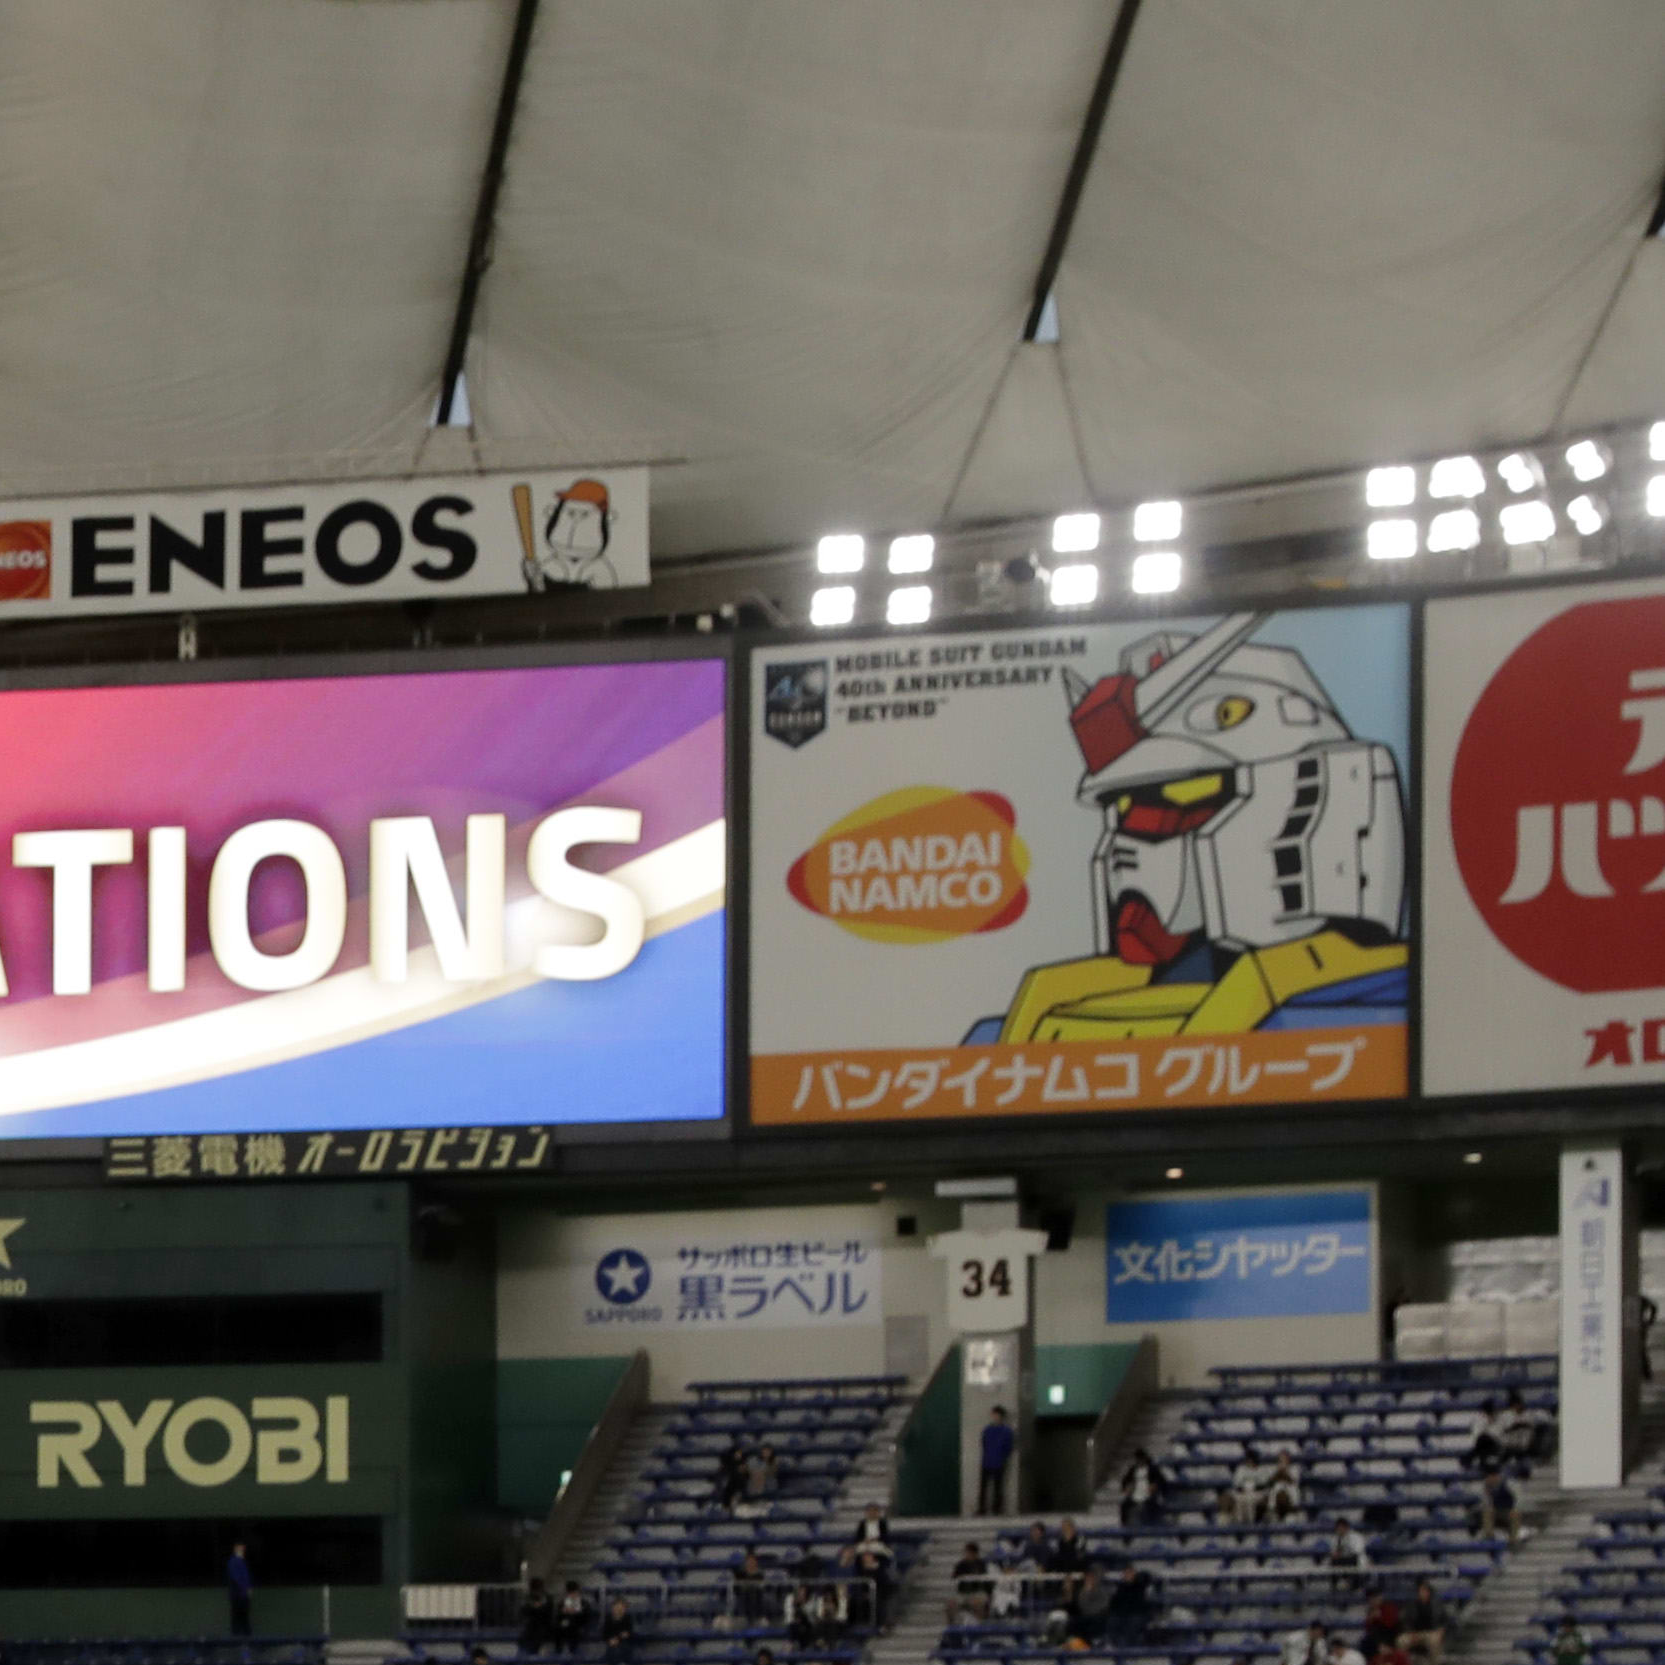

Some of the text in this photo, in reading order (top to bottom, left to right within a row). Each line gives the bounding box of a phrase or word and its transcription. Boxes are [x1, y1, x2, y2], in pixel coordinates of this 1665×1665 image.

[71, 495, 477, 599] ENEOS
[835, 638, 1088, 674] MOBILE SUIT GUNDAM
[894, 665, 1054, 694] ANNIVERSARY
[827, 832, 1003, 876] BANDAI
[828, 871, 1004, 915] NAMCO
[793, 1036, 1367, 1112] バンダイナムコ グループ
[108, 1134, 286, 1177] 三菱電機
[677, 1240, 867, 1270] サッポロ生ビール
[677, 1272, 867, 1321] 黒ラベル
[962, 1257, 1011, 1298] 34
[584, 1304, 663, 1326] SAPPORO
[29, 1396, 349, 1489] RYOBI
